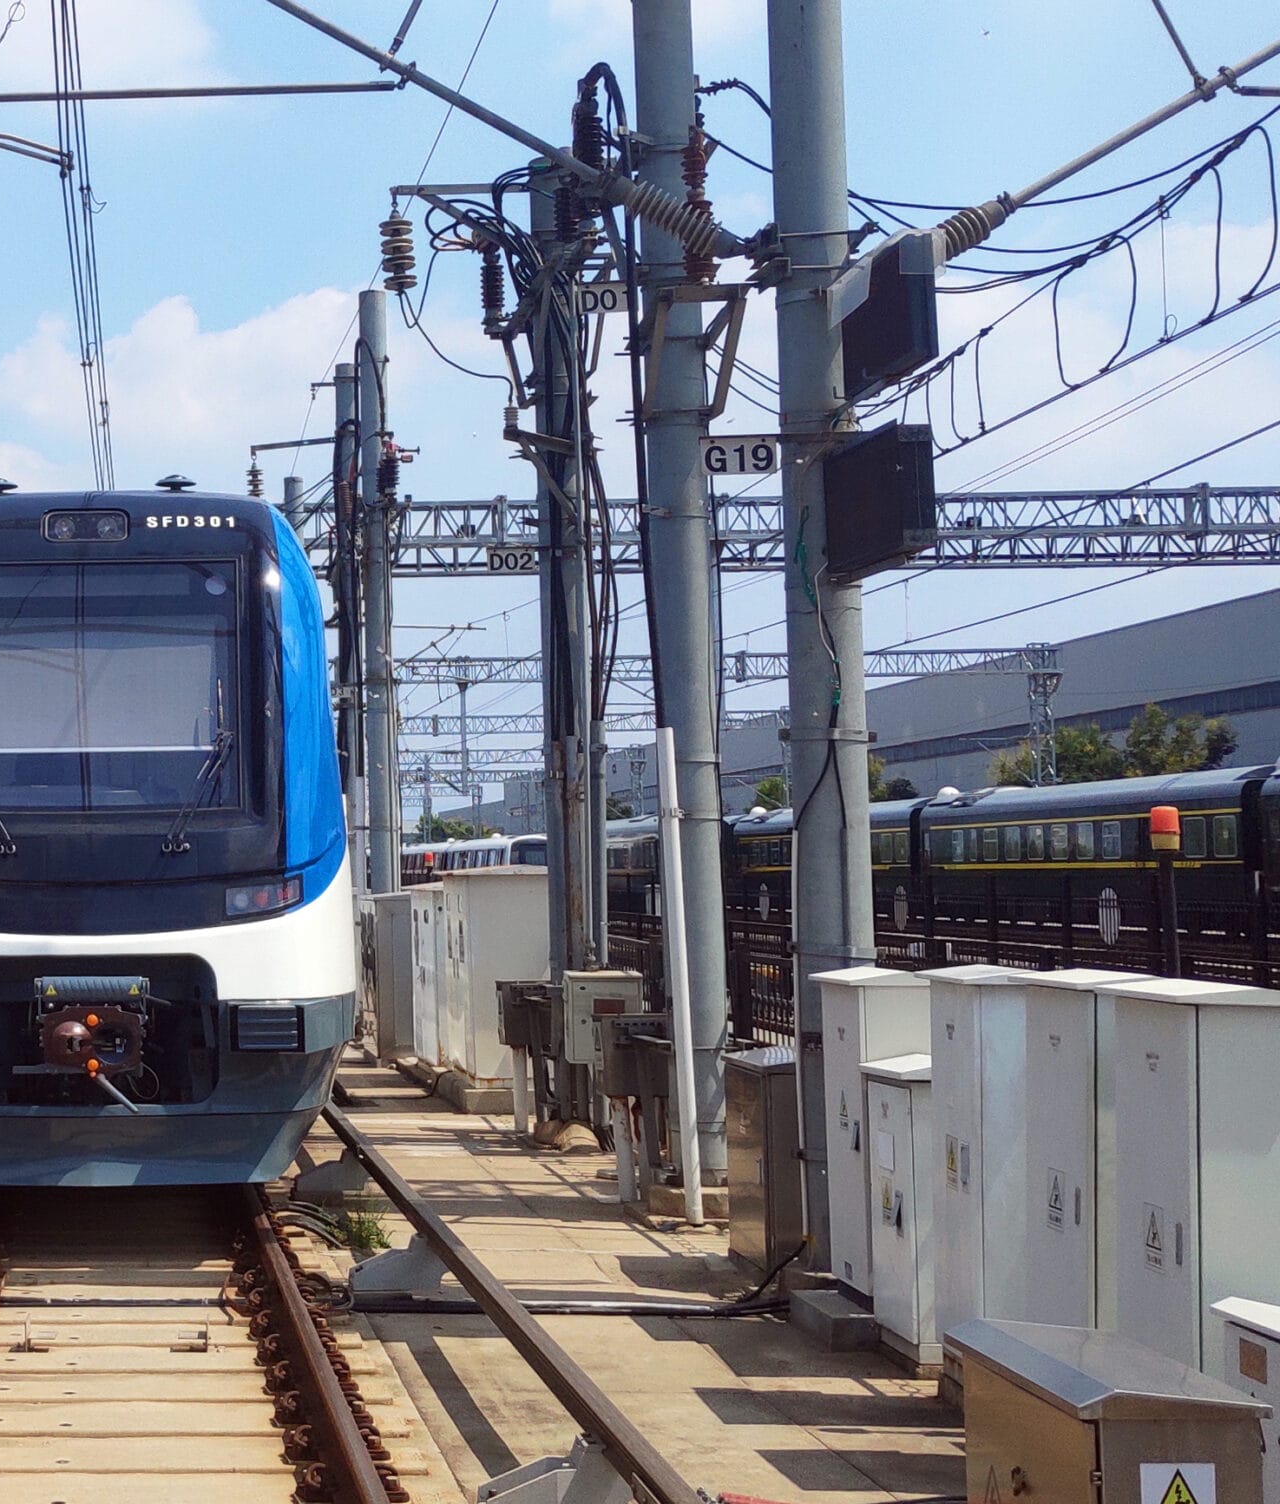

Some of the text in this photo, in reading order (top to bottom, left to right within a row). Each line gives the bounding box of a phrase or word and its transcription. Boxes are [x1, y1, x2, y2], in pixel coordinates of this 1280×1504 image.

[705, 444, 773, 473] G19
[146, 515, 235, 528] SFD301
[490, 553, 533, 571] D02
